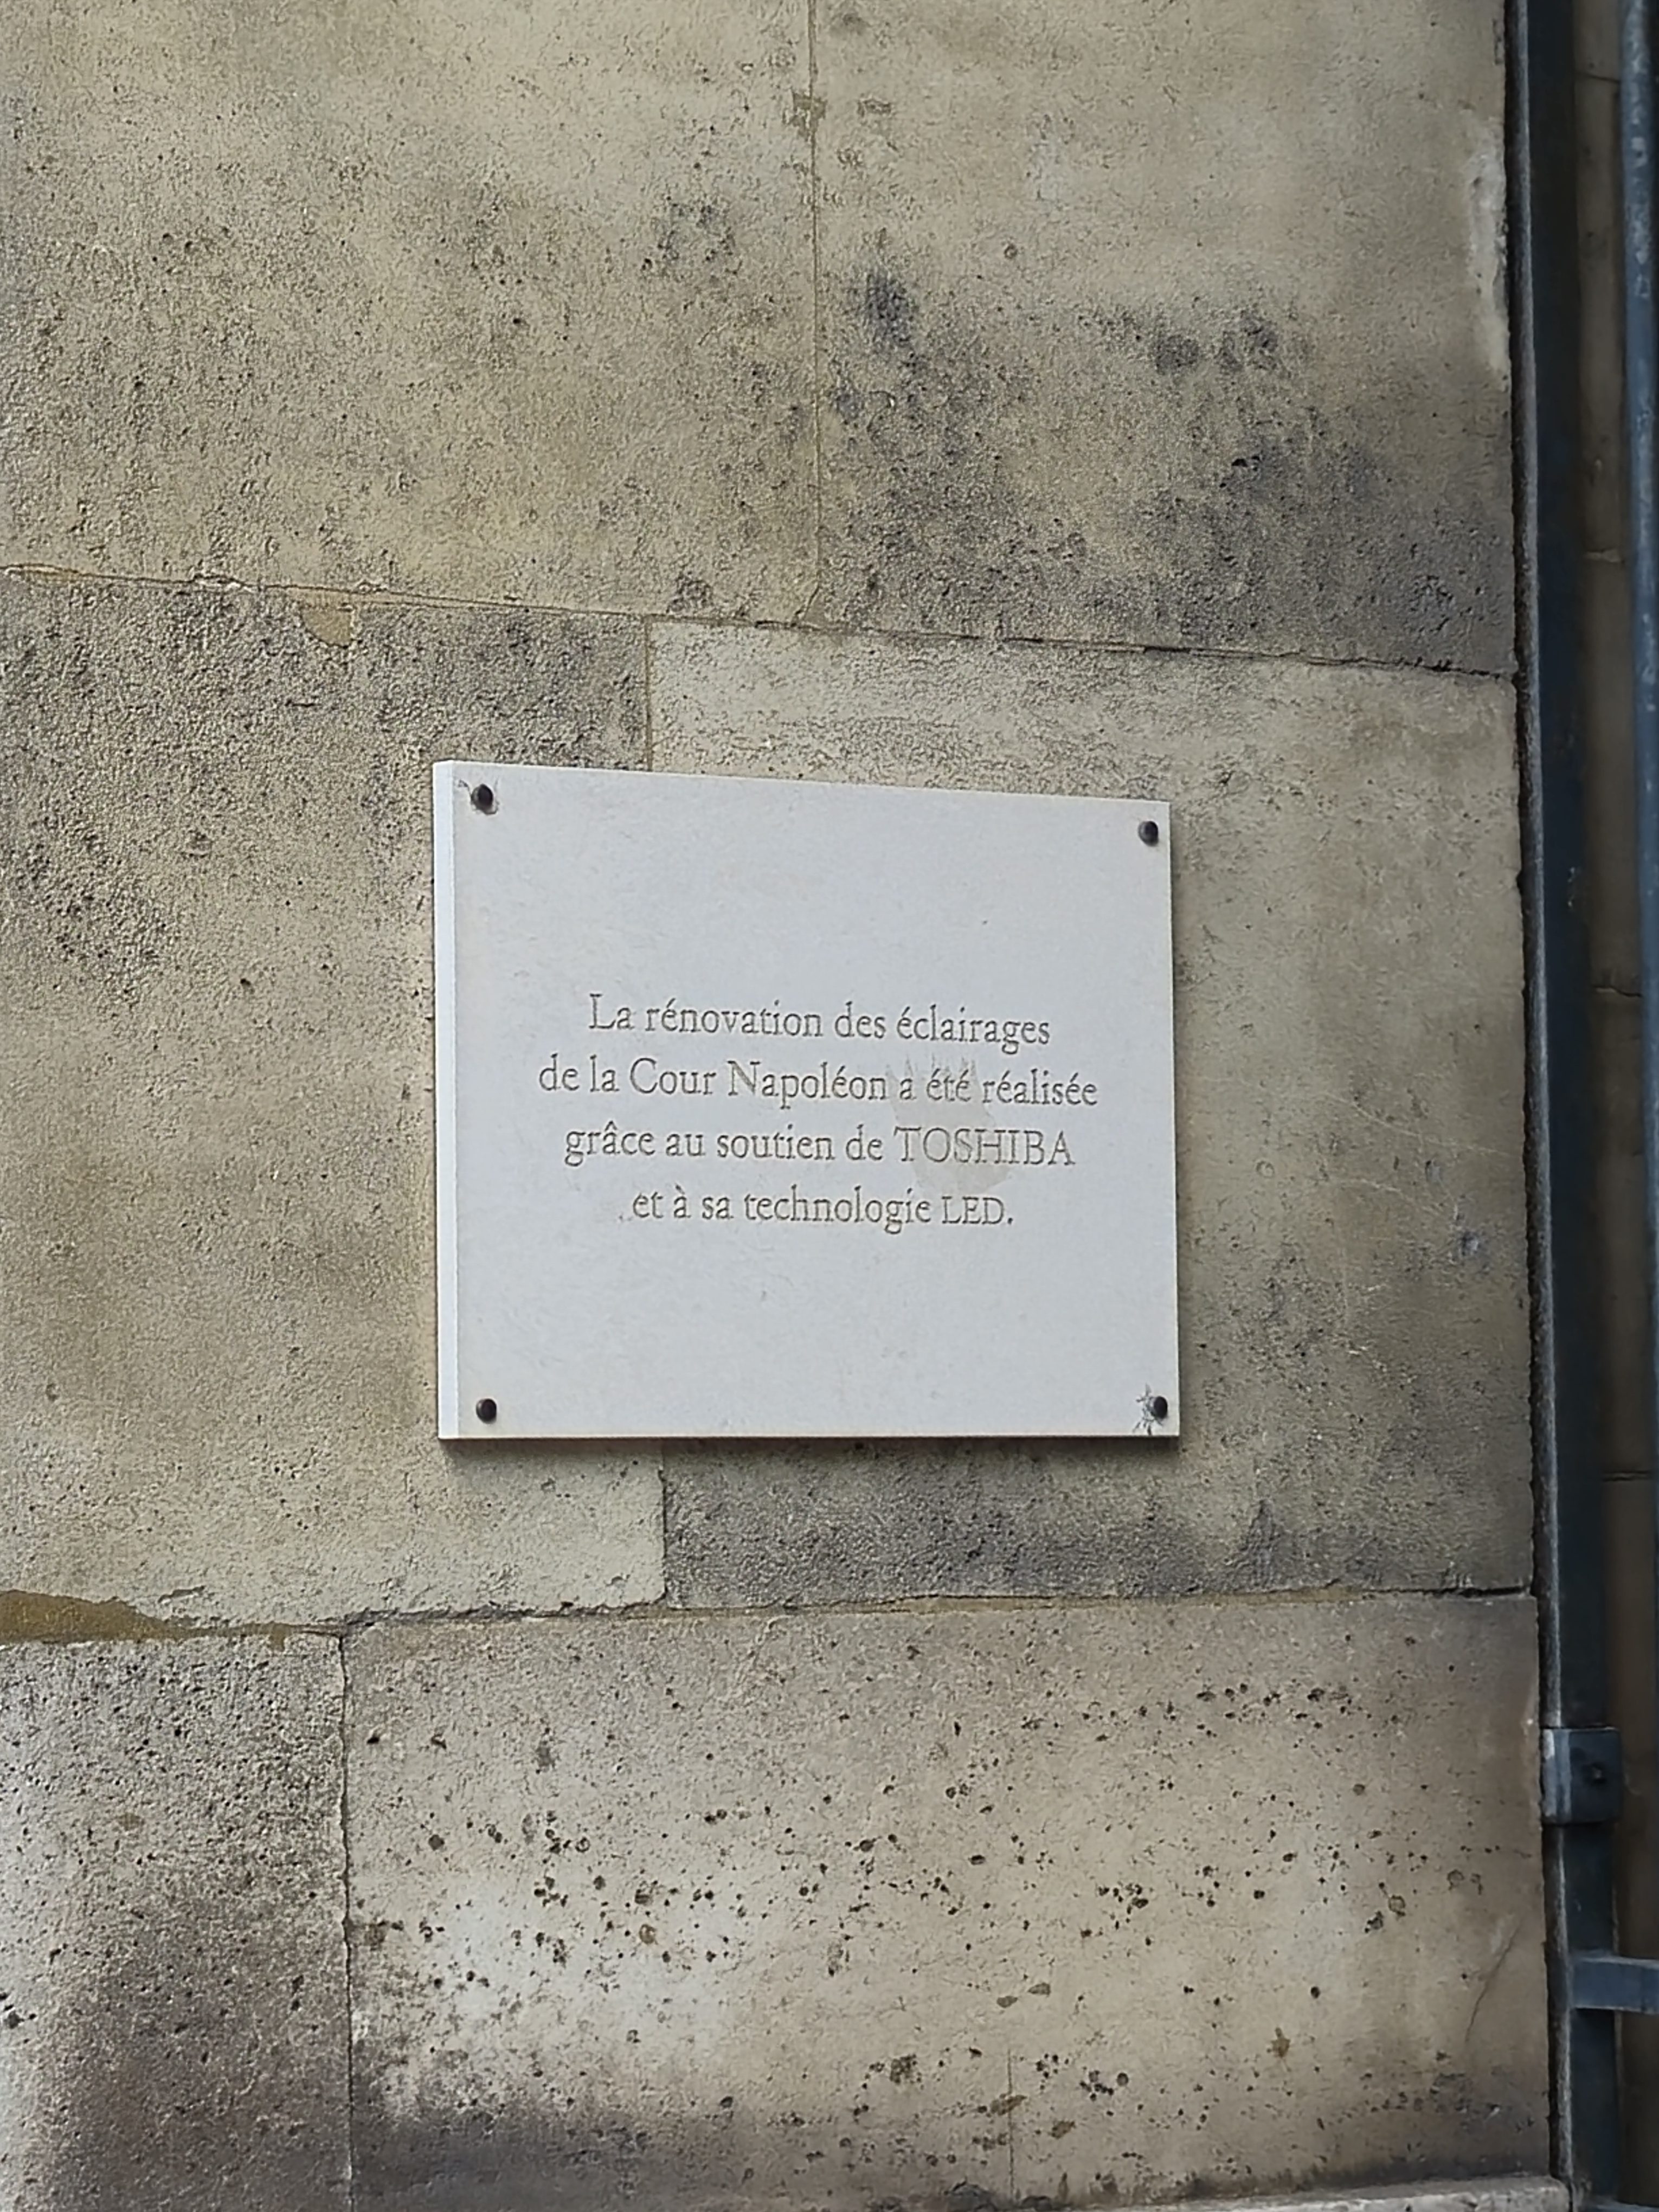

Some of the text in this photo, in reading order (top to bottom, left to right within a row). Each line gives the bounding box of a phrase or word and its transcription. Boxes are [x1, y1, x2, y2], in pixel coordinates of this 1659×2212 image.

[589, 993, 1050, 1056] La rénovation des éclairages
[539, 1053, 1098, 1110] de la Cour Napoléon a été réalisée
[564, 1120, 1076, 1167] grâce au soutien de TOSHIBA
[632, 1184, 1014, 1235] et à sa technologie LED.
